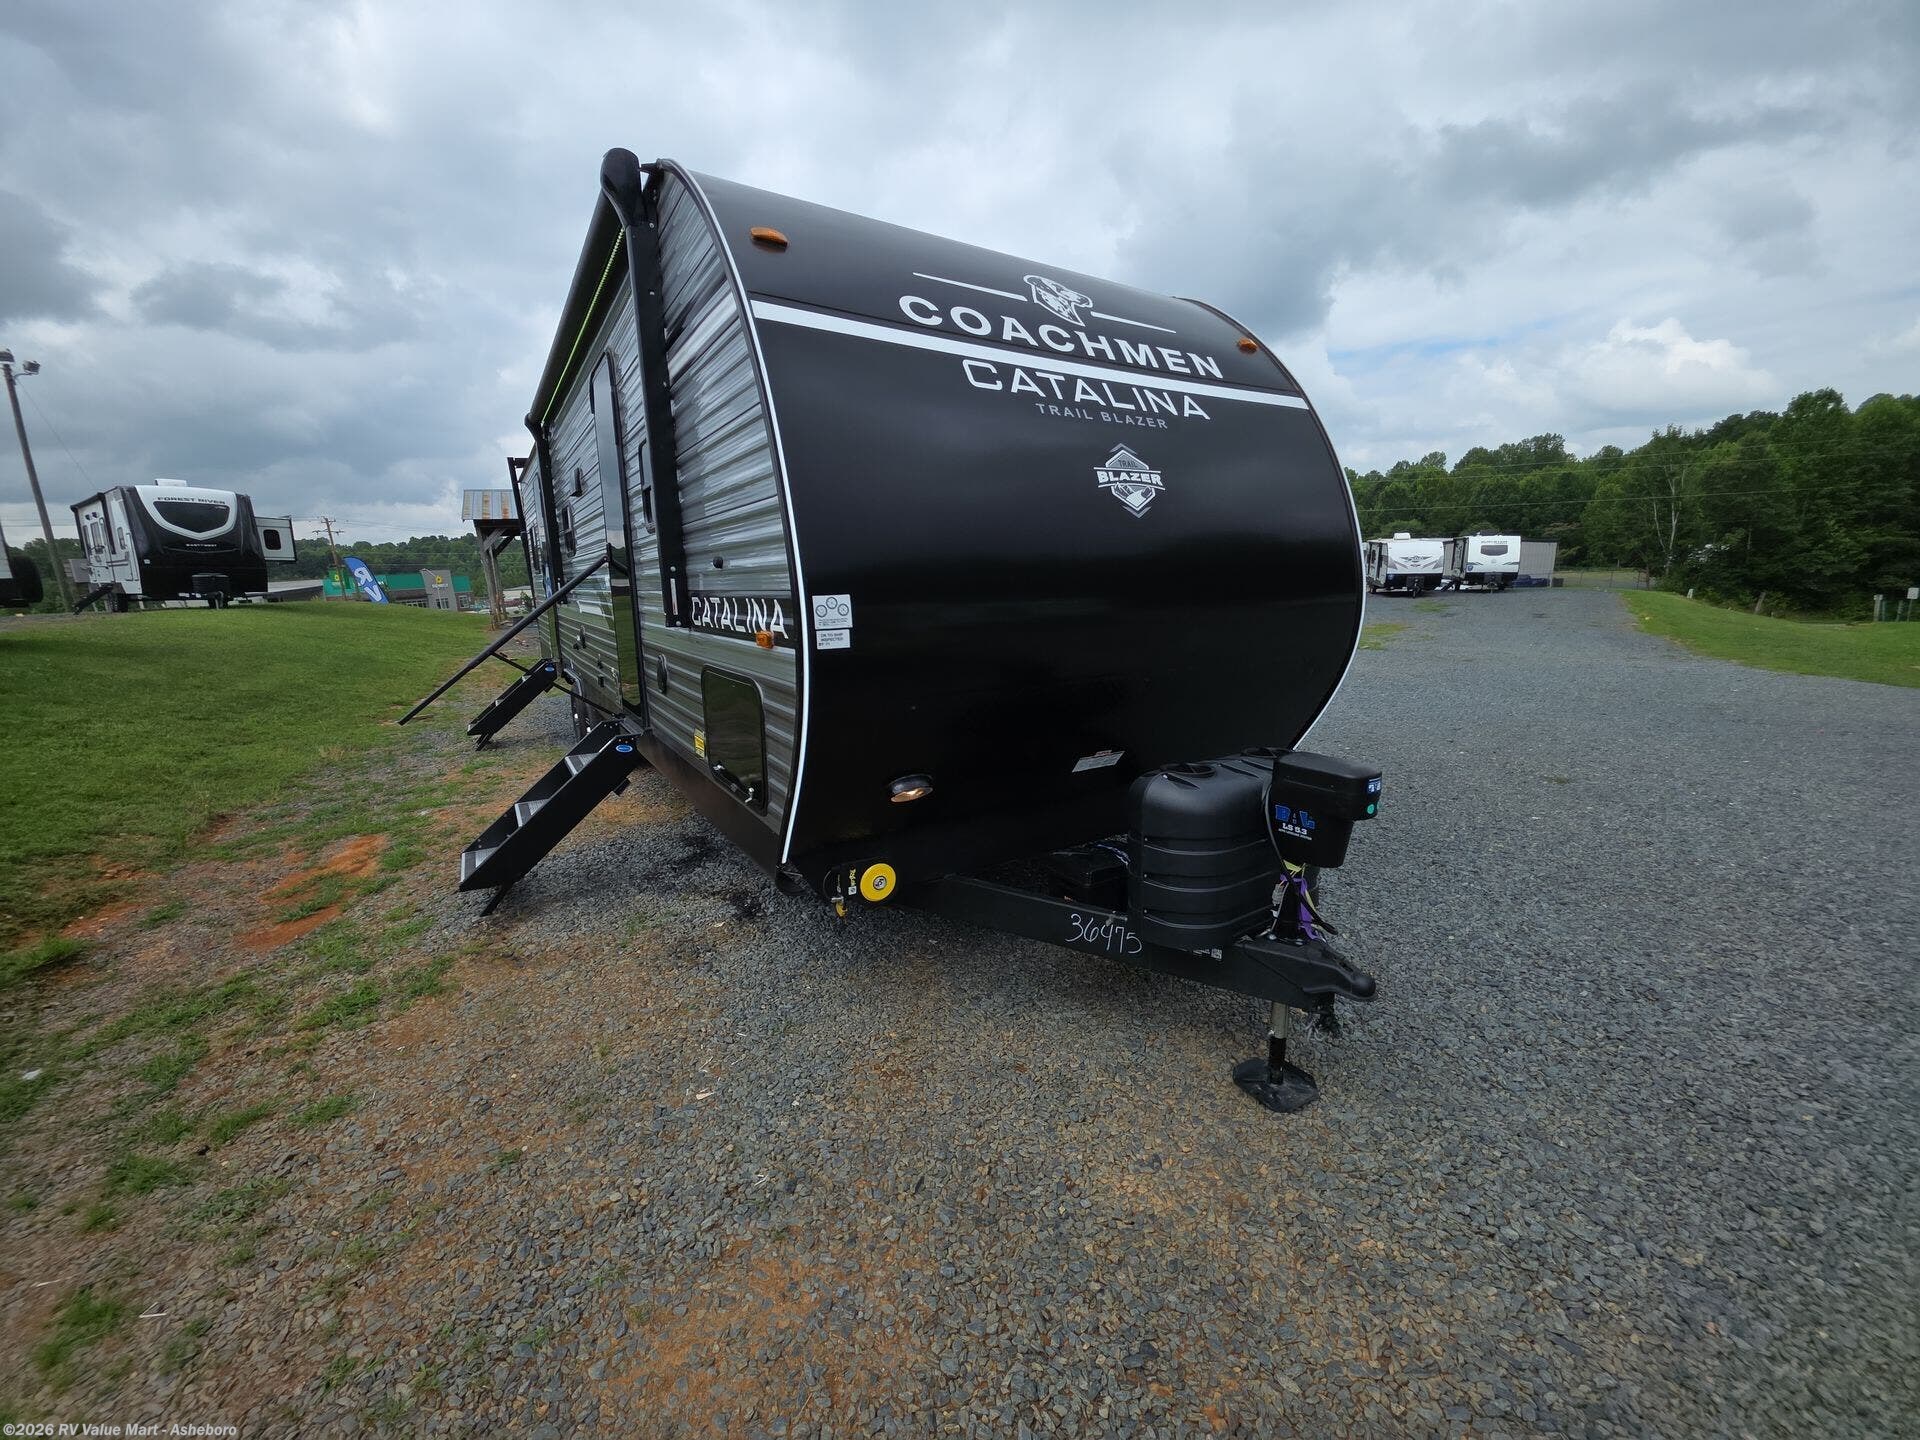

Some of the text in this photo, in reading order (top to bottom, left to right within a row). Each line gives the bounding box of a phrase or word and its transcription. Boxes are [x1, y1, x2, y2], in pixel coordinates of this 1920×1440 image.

[899, 295, 1223, 379] COACHMEN
[962, 359, 1211, 420] CATALINA
[1035, 402, 1168, 429] TRAIL BLAZER
[1096, 470, 1164, 486] BLAZER
[354, 567, 382, 602] RV
[691, 596, 789, 639] CATALINA
[1065, 913, 1142, 953] 36475
